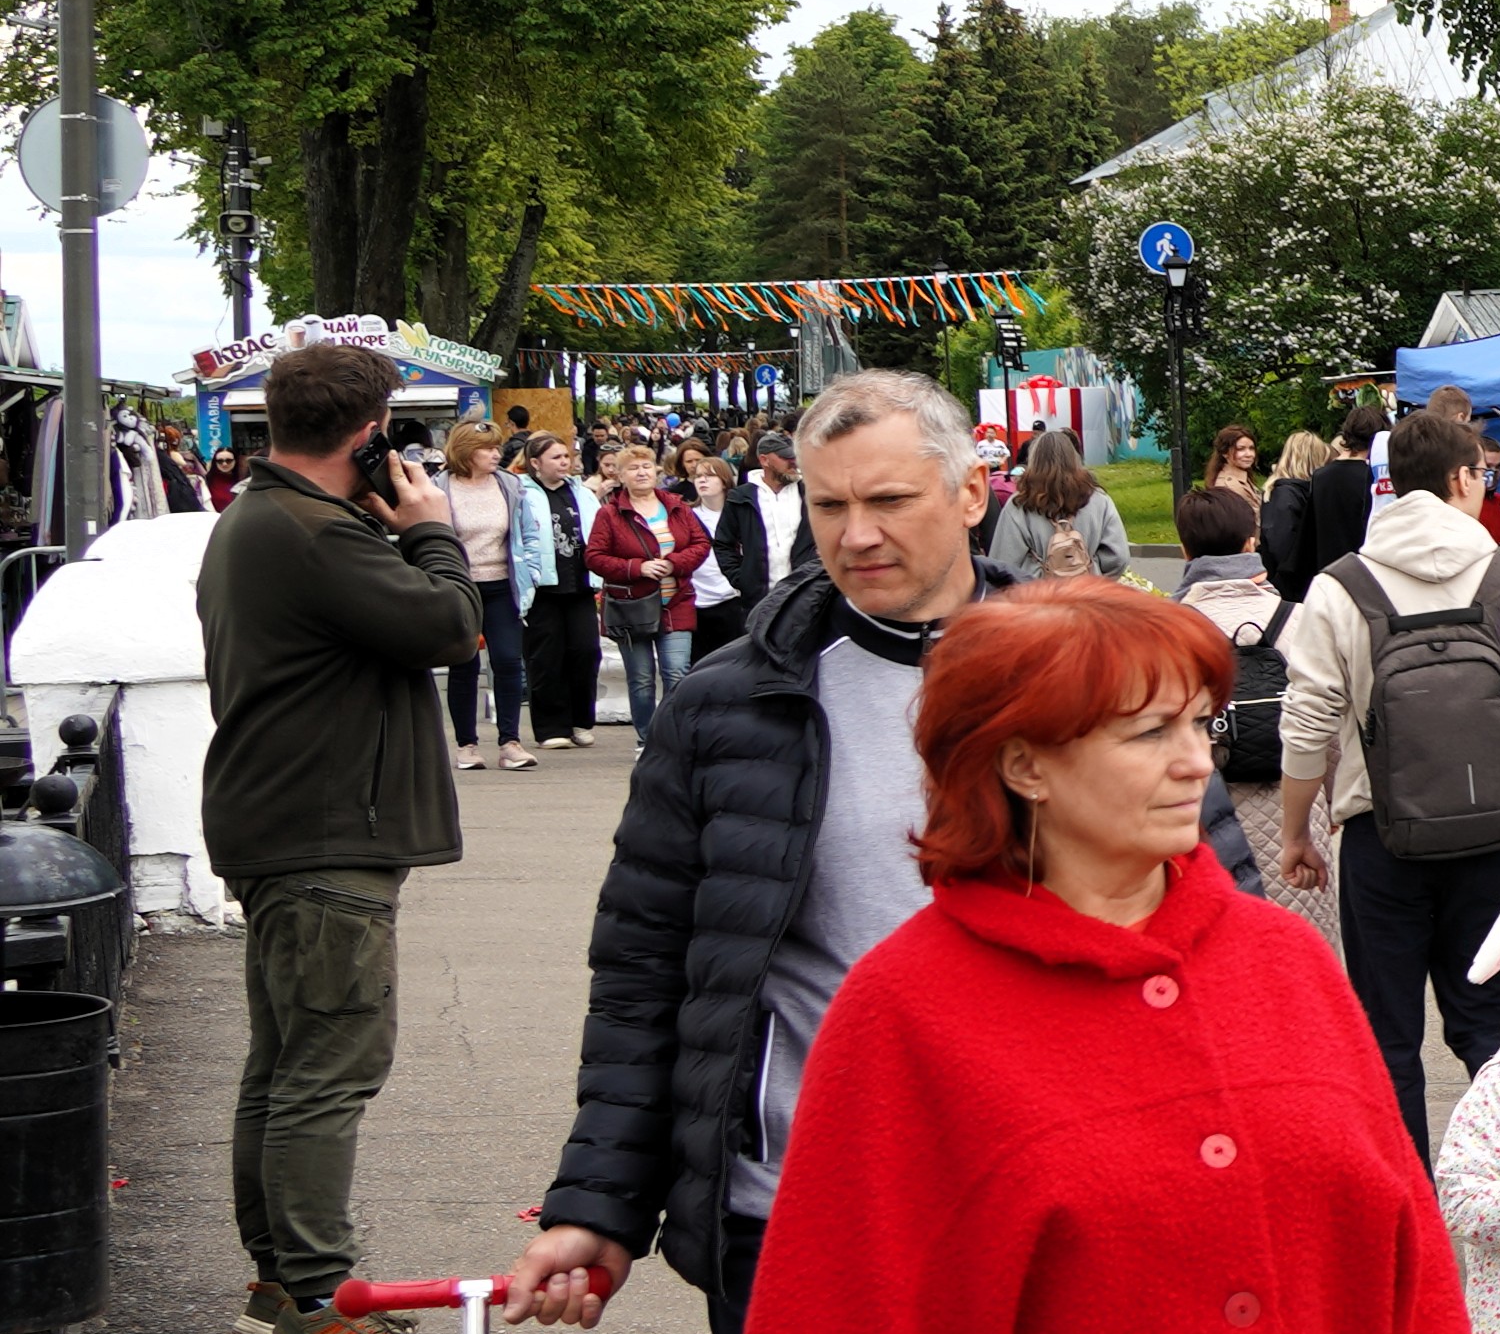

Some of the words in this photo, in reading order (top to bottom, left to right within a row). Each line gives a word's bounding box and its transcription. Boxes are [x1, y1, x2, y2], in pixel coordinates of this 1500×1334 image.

[323, 317, 358, 333] ЧАЙ
[341, 335, 386, 347] КОФЕ
[213, 332, 278, 367] КВАС
[411, 344, 496, 382] КУКУРУЗА
[428, 335, 502, 368] ГОРЯЧАЯ
